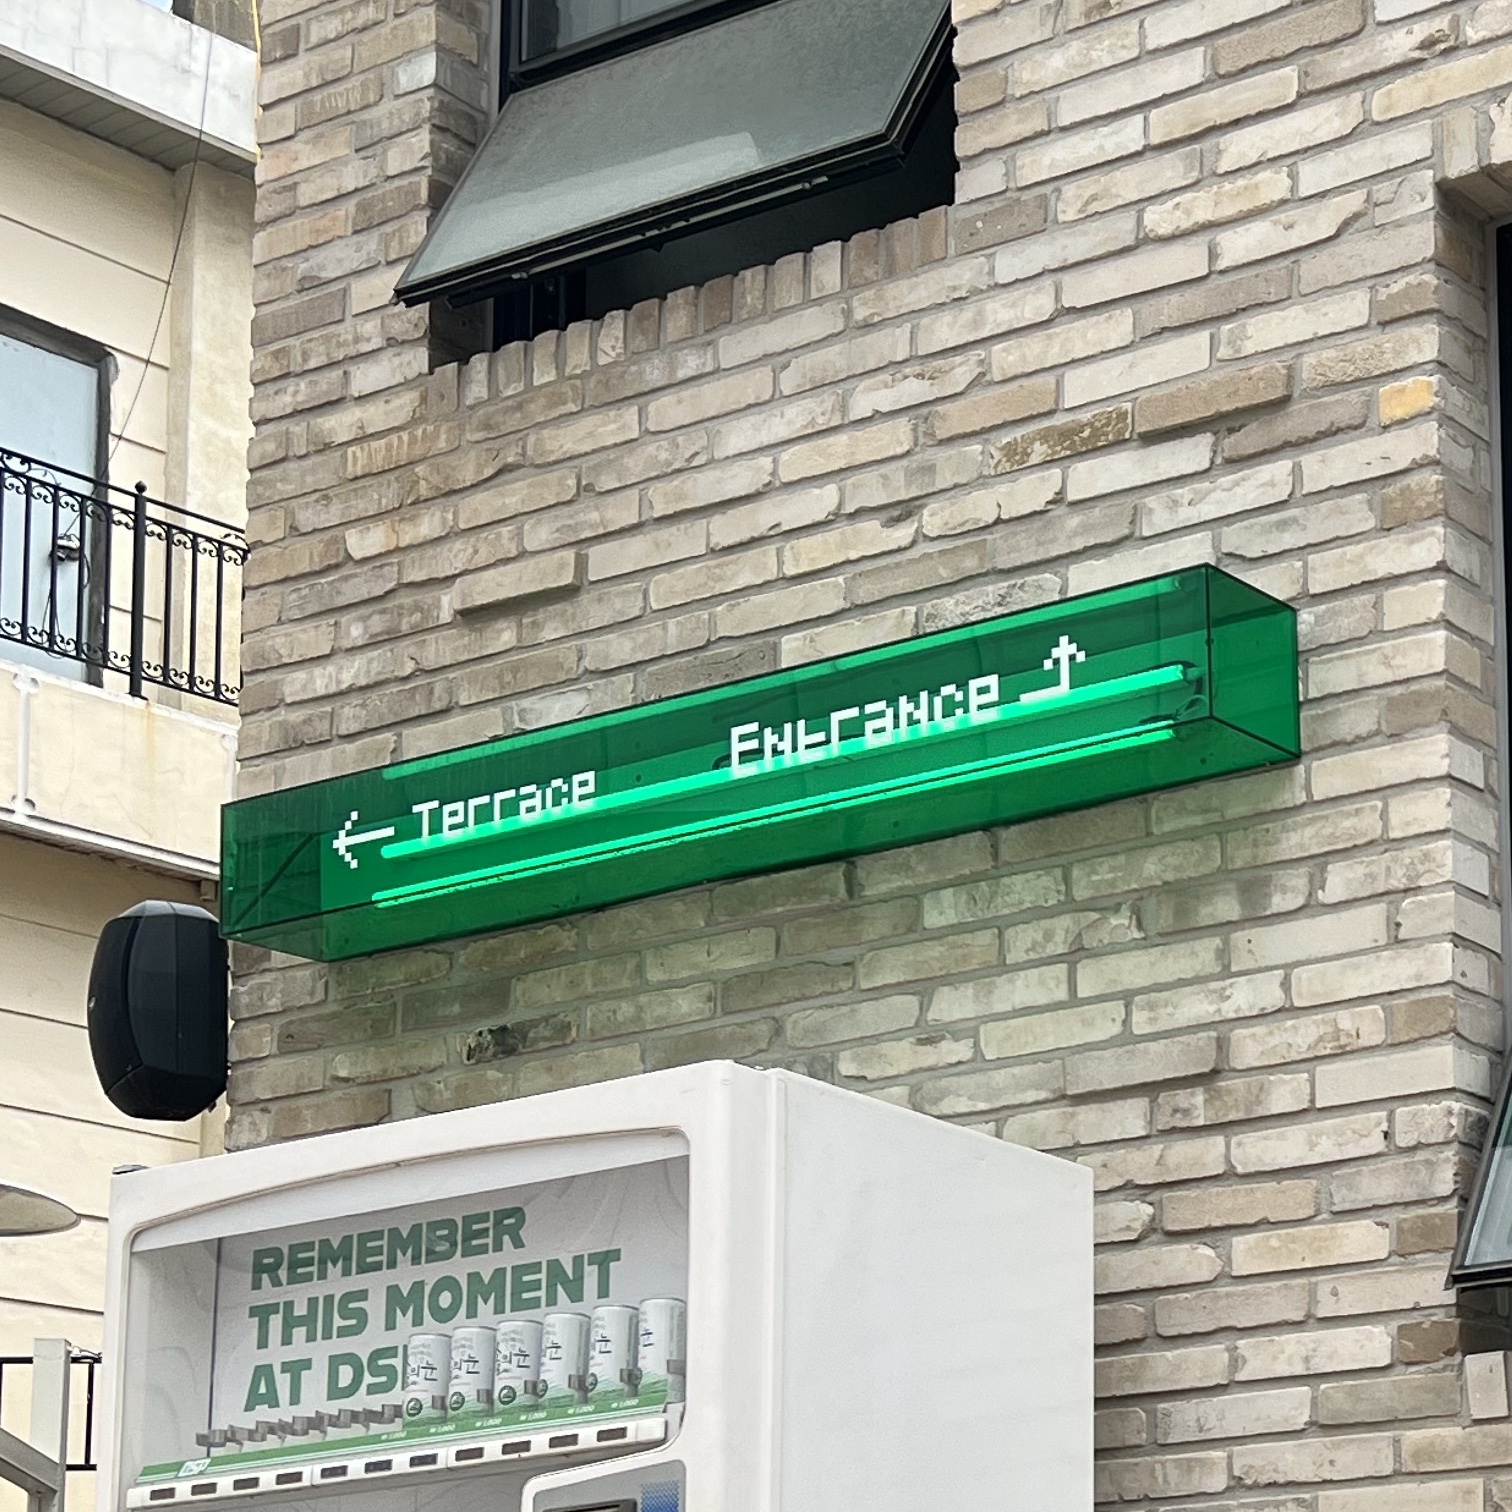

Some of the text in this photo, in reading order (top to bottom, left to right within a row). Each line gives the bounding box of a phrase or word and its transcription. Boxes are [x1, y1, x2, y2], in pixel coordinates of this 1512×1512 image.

[412, 771, 596, 844] Terrace
[251, 1206, 526, 1291] REMEMBER
[248, 1248, 622, 1350] THIS MOMENT
[244, 1344, 408, 1412] AT DS
